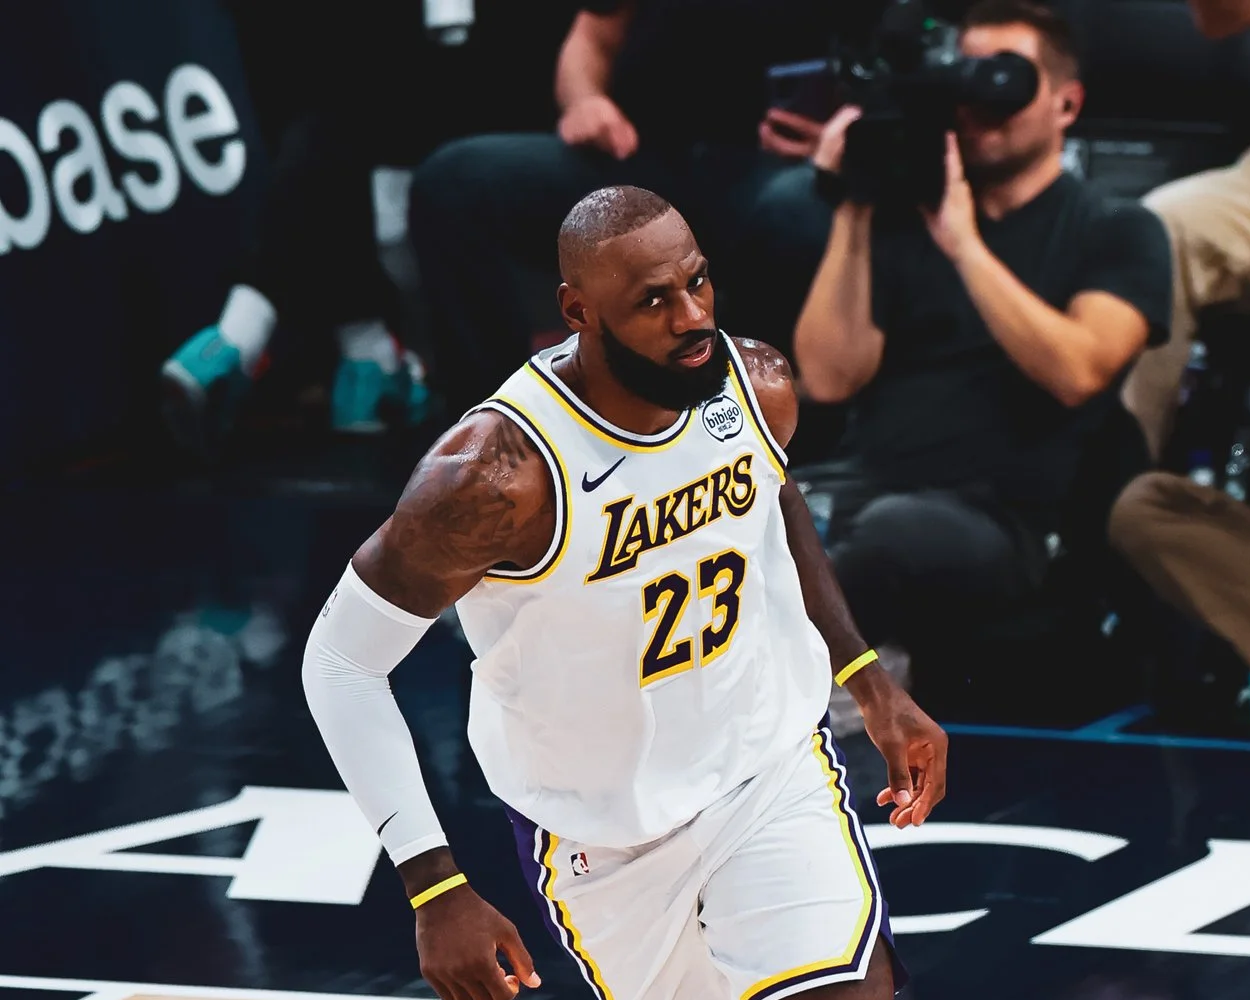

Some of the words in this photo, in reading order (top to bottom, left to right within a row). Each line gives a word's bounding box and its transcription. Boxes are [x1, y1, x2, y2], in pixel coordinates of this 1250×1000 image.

[706, 406, 740, 429] bibigo
[584, 454, 757, 586] LAKERS
[638, 548, 749, 690] 23
